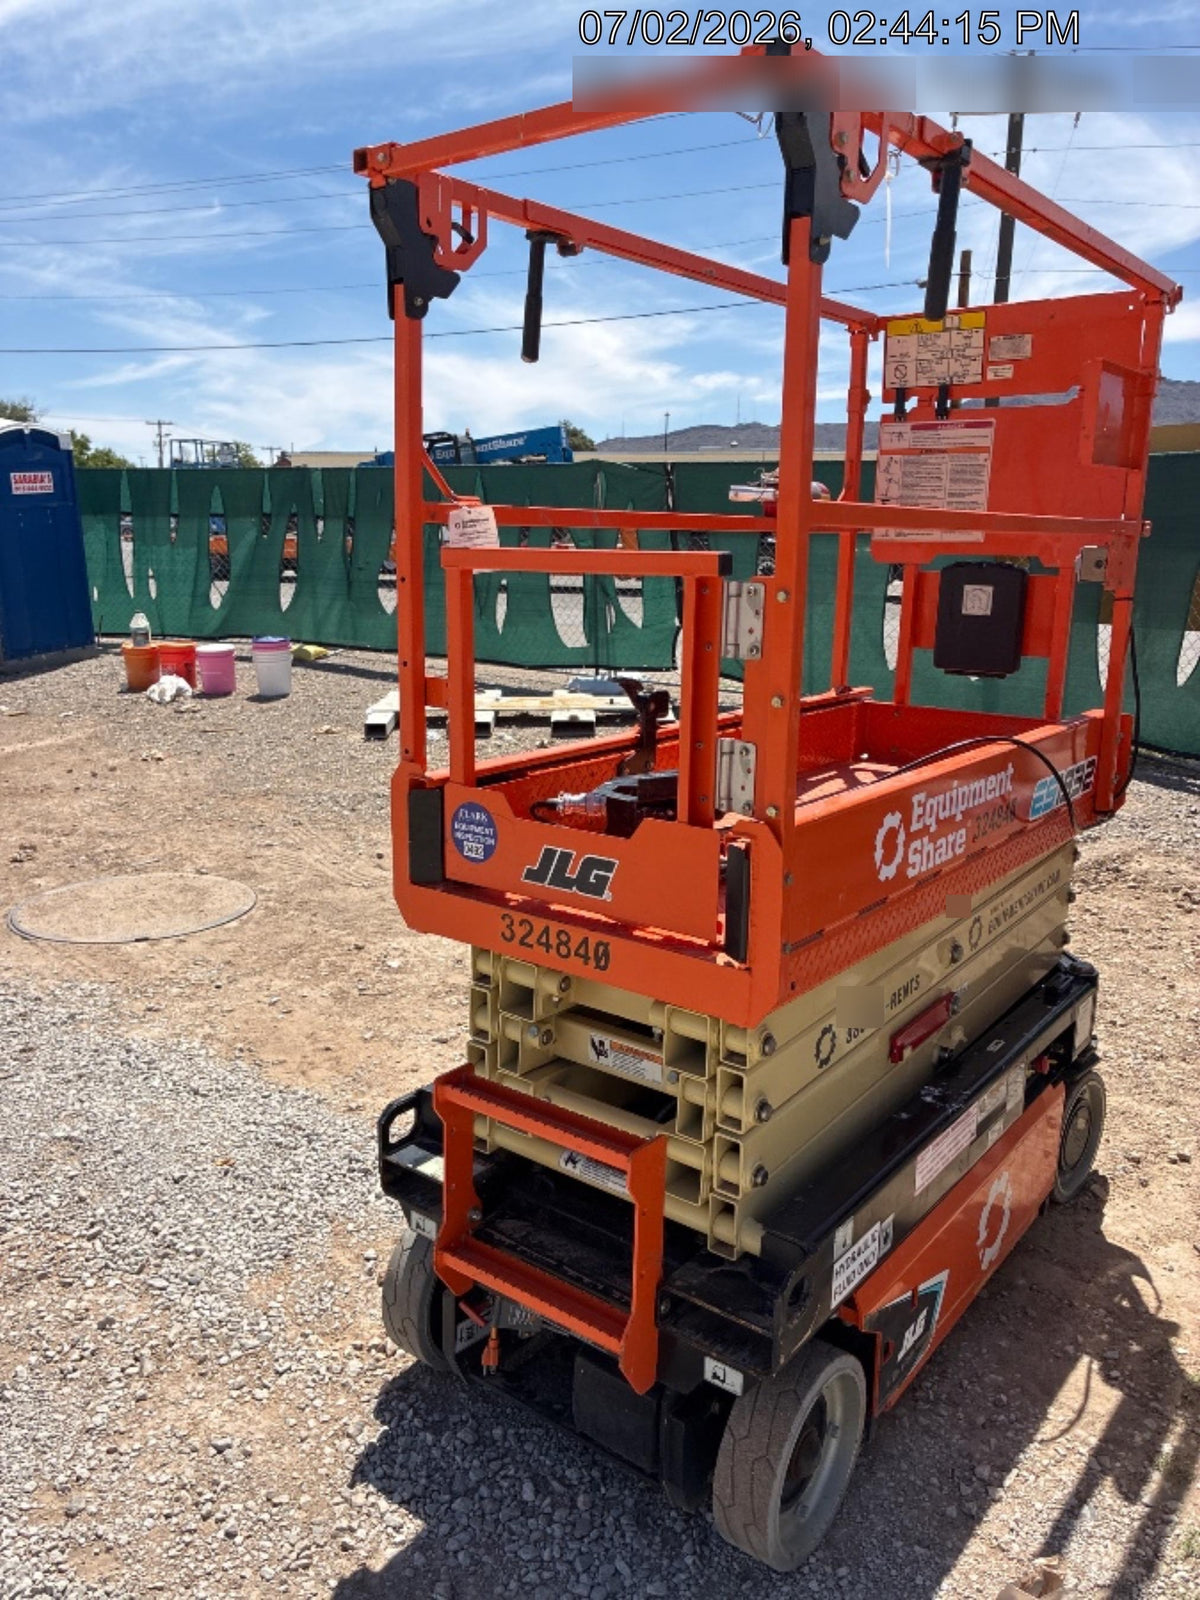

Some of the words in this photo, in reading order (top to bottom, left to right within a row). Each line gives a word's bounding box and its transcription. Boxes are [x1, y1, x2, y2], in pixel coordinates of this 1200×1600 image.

[459, 808, 488, 822] CLARK
[910, 763, 1014, 832] Equipment
[454, 821, 494, 836] EQUIPMENT
[906, 828, 966, 878] Share
[521, 845, 619, 901] JLG
[897, 1306, 928, 1363] JLG
